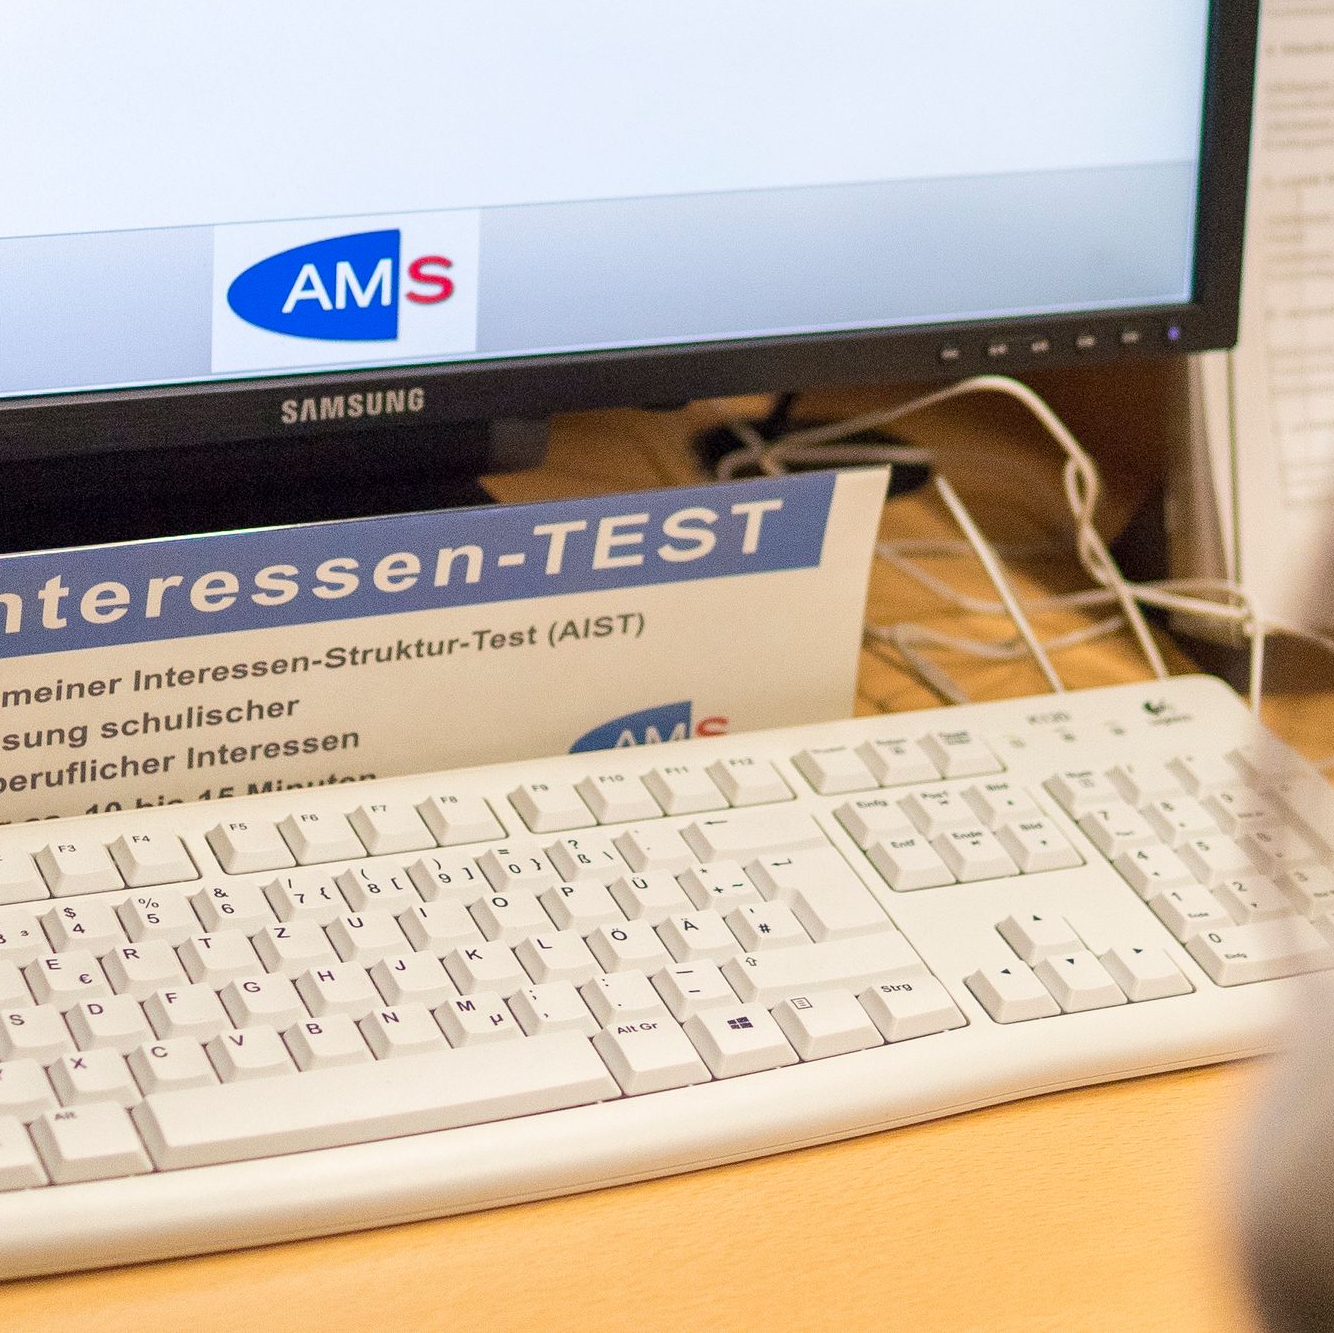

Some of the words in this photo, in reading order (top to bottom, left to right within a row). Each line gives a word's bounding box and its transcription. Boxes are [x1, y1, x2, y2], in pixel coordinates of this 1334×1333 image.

[281, 254, 455, 314] AMS
[281, 388, 425, 424] SAMSUNG
[133, 625, 539, 692] Interessen-Struktur-Test
[548, 612, 646, 649] (AIST)
[100, 696, 301, 740] schulischer
[187, 729, 360, 771] Interessen
[531, 784, 549, 792] F9
[439, 795, 458, 804] F8
[370, 804, 387, 813] F7
[300, 814, 319, 822] F6
[229, 822, 248, 831] F5
[131, 835, 151, 843] F4
[57, 844, 77, 853] F3
[508, 863, 522, 874] 0
[438, 873, 452, 884] 9
[631, 876, 650, 890] Ü
[367, 883, 381, 894] 8
[560, 886, 574, 897] P
[295, 893, 305, 904] 7
[491, 897, 509, 908] O
[221, 903, 235, 914] 6
[146, 913, 160, 924] 5
[347, 917, 364, 929] U
[681, 917, 700, 932] Ä
[72, 923, 86, 934] 4
[274, 927, 292, 939] Z
[610, 927, 628, 941] Ö
[198, 937, 211, 949] T
[536, 938, 552, 950] L
[122, 948, 140, 960] R
[465, 949, 483, 960] K
[45, 958, 61, 971] E
[395, 959, 407, 971] J
[317, 970, 335, 982] H
[242, 981, 261, 993] G
[880, 983, 913, 993] Strg
[165, 992, 176, 1004] F
[86, 1003, 104, 1015] D
[456, 1000, 476, 1012] M
[8, 1014, 25, 1026] S
[381, 1012, 400, 1024] N
[305, 1023, 323, 1035] B
[617, 1025, 638, 1035] Alt
[639, 1022, 657, 1031] Gr
[229, 1034, 244, 1047] V
[150, 1046, 168, 1059] C
[72, 1057, 86, 1069] X
